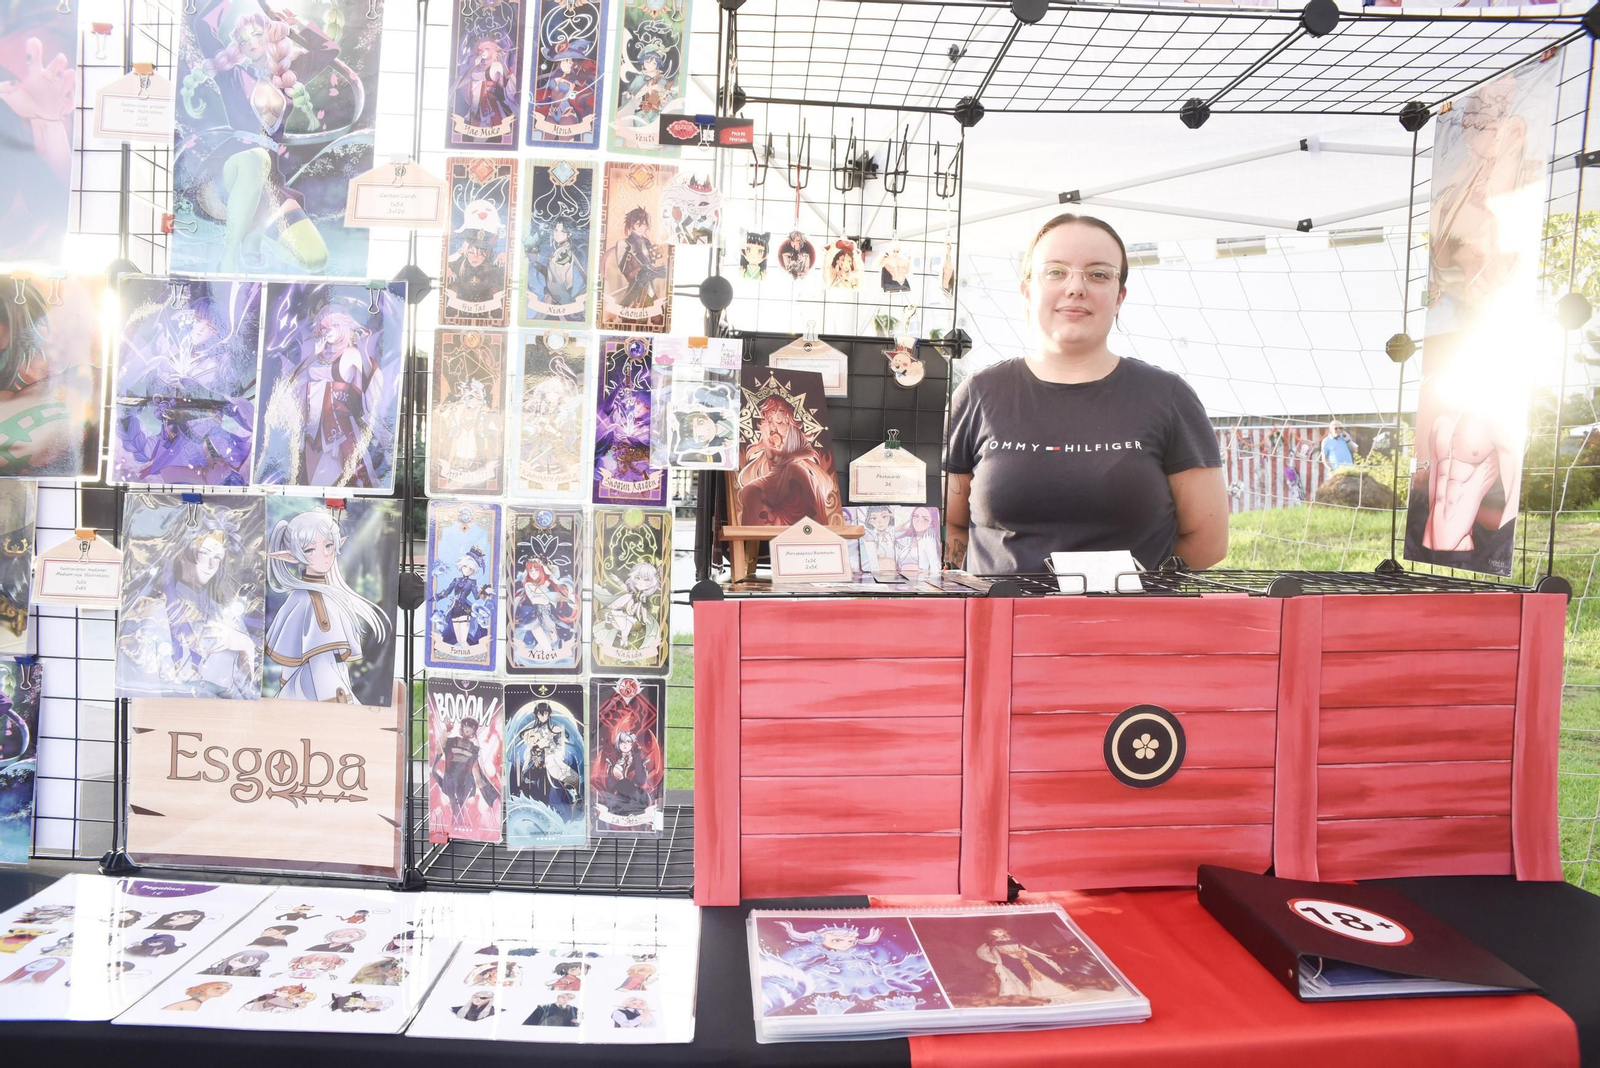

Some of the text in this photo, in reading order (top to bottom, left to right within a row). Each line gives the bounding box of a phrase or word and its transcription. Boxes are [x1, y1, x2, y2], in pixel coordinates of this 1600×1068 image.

[464, 124, 501, 137] Yae Miko
[551, 125, 572, 135] Mona
[635, 133, 655, 142] Venti
[462, 303, 473, 311] Hu
[546, 306, 566, 314] Xiao
[989, 440, 1143, 452] OMMY HILFIGER
[604, 477, 630, 492] Shogun
[450, 646, 471, 656] Furina
[528, 650, 558, 660] Nilou
[615, 650, 643, 660] Nahida
[433, 692, 498, 726] BOOOM
[166, 731, 368, 804] Esgoba
[141, 884, 186, 892] Pegatinas
[1301, 907, 1393, 932] 18+
